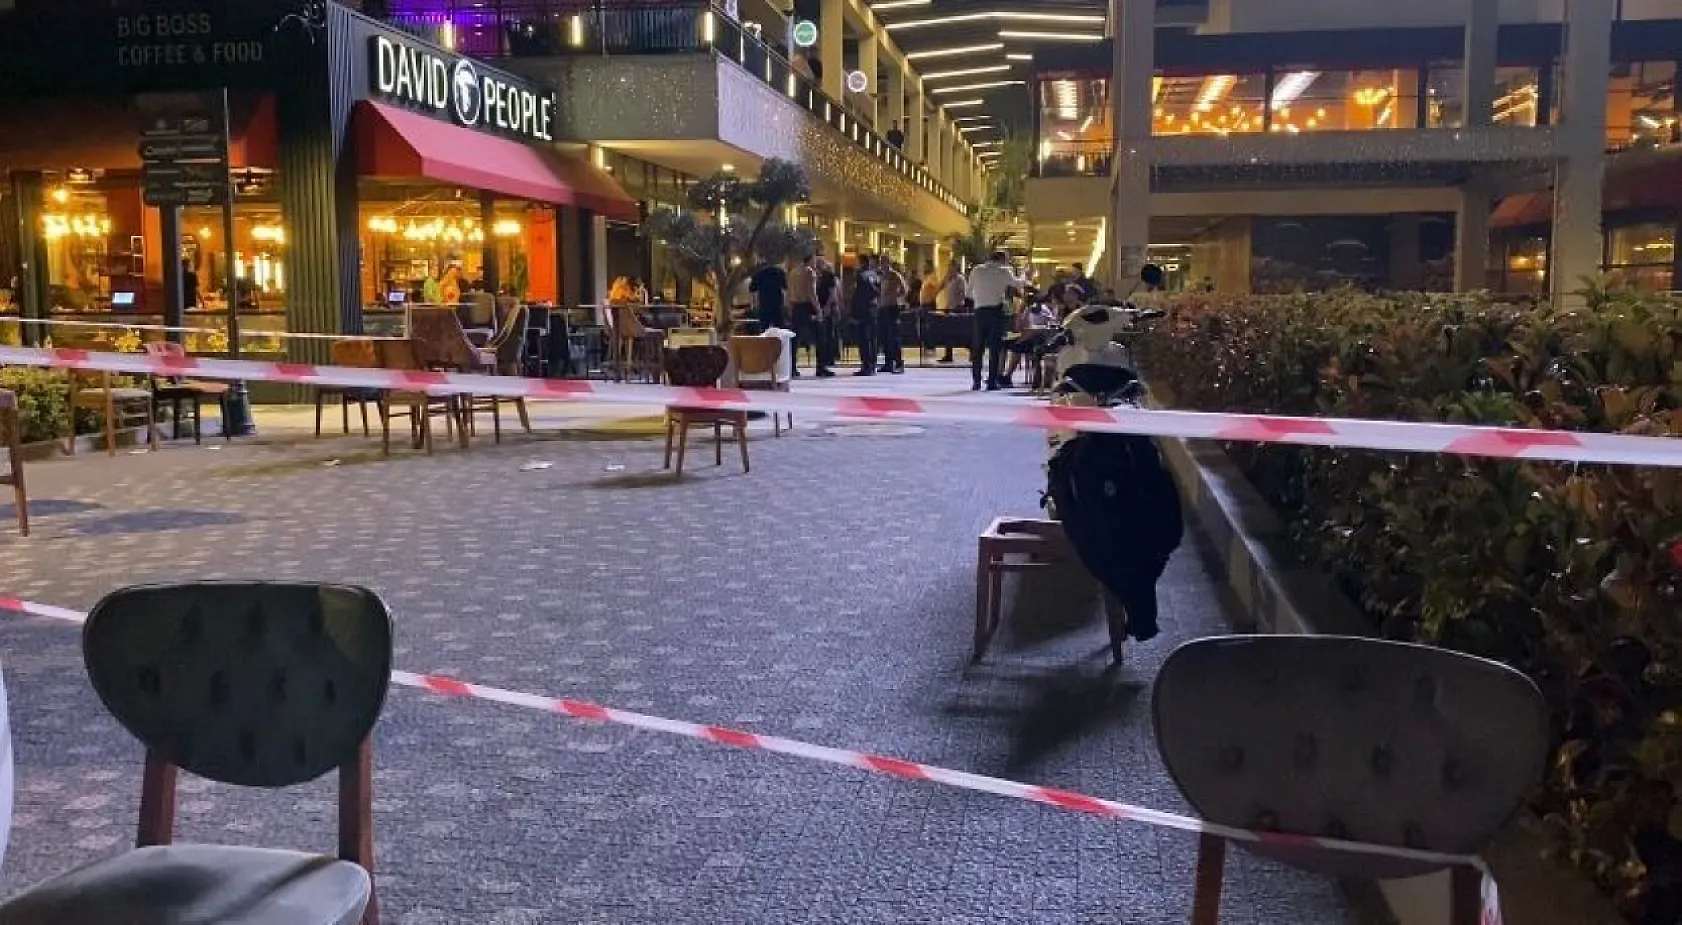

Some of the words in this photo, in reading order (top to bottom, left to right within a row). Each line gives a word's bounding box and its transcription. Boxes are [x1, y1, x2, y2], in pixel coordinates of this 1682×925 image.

[117, 15, 151, 37] BIG
[156, 13, 212, 36] BOSS
[117, 43, 186, 66] COFFEE
[193, 45, 207, 65] &
[212, 40, 264, 64] FOOD
[377, 36, 449, 109] DAVID
[483, 76, 553, 141] PEOPLE
